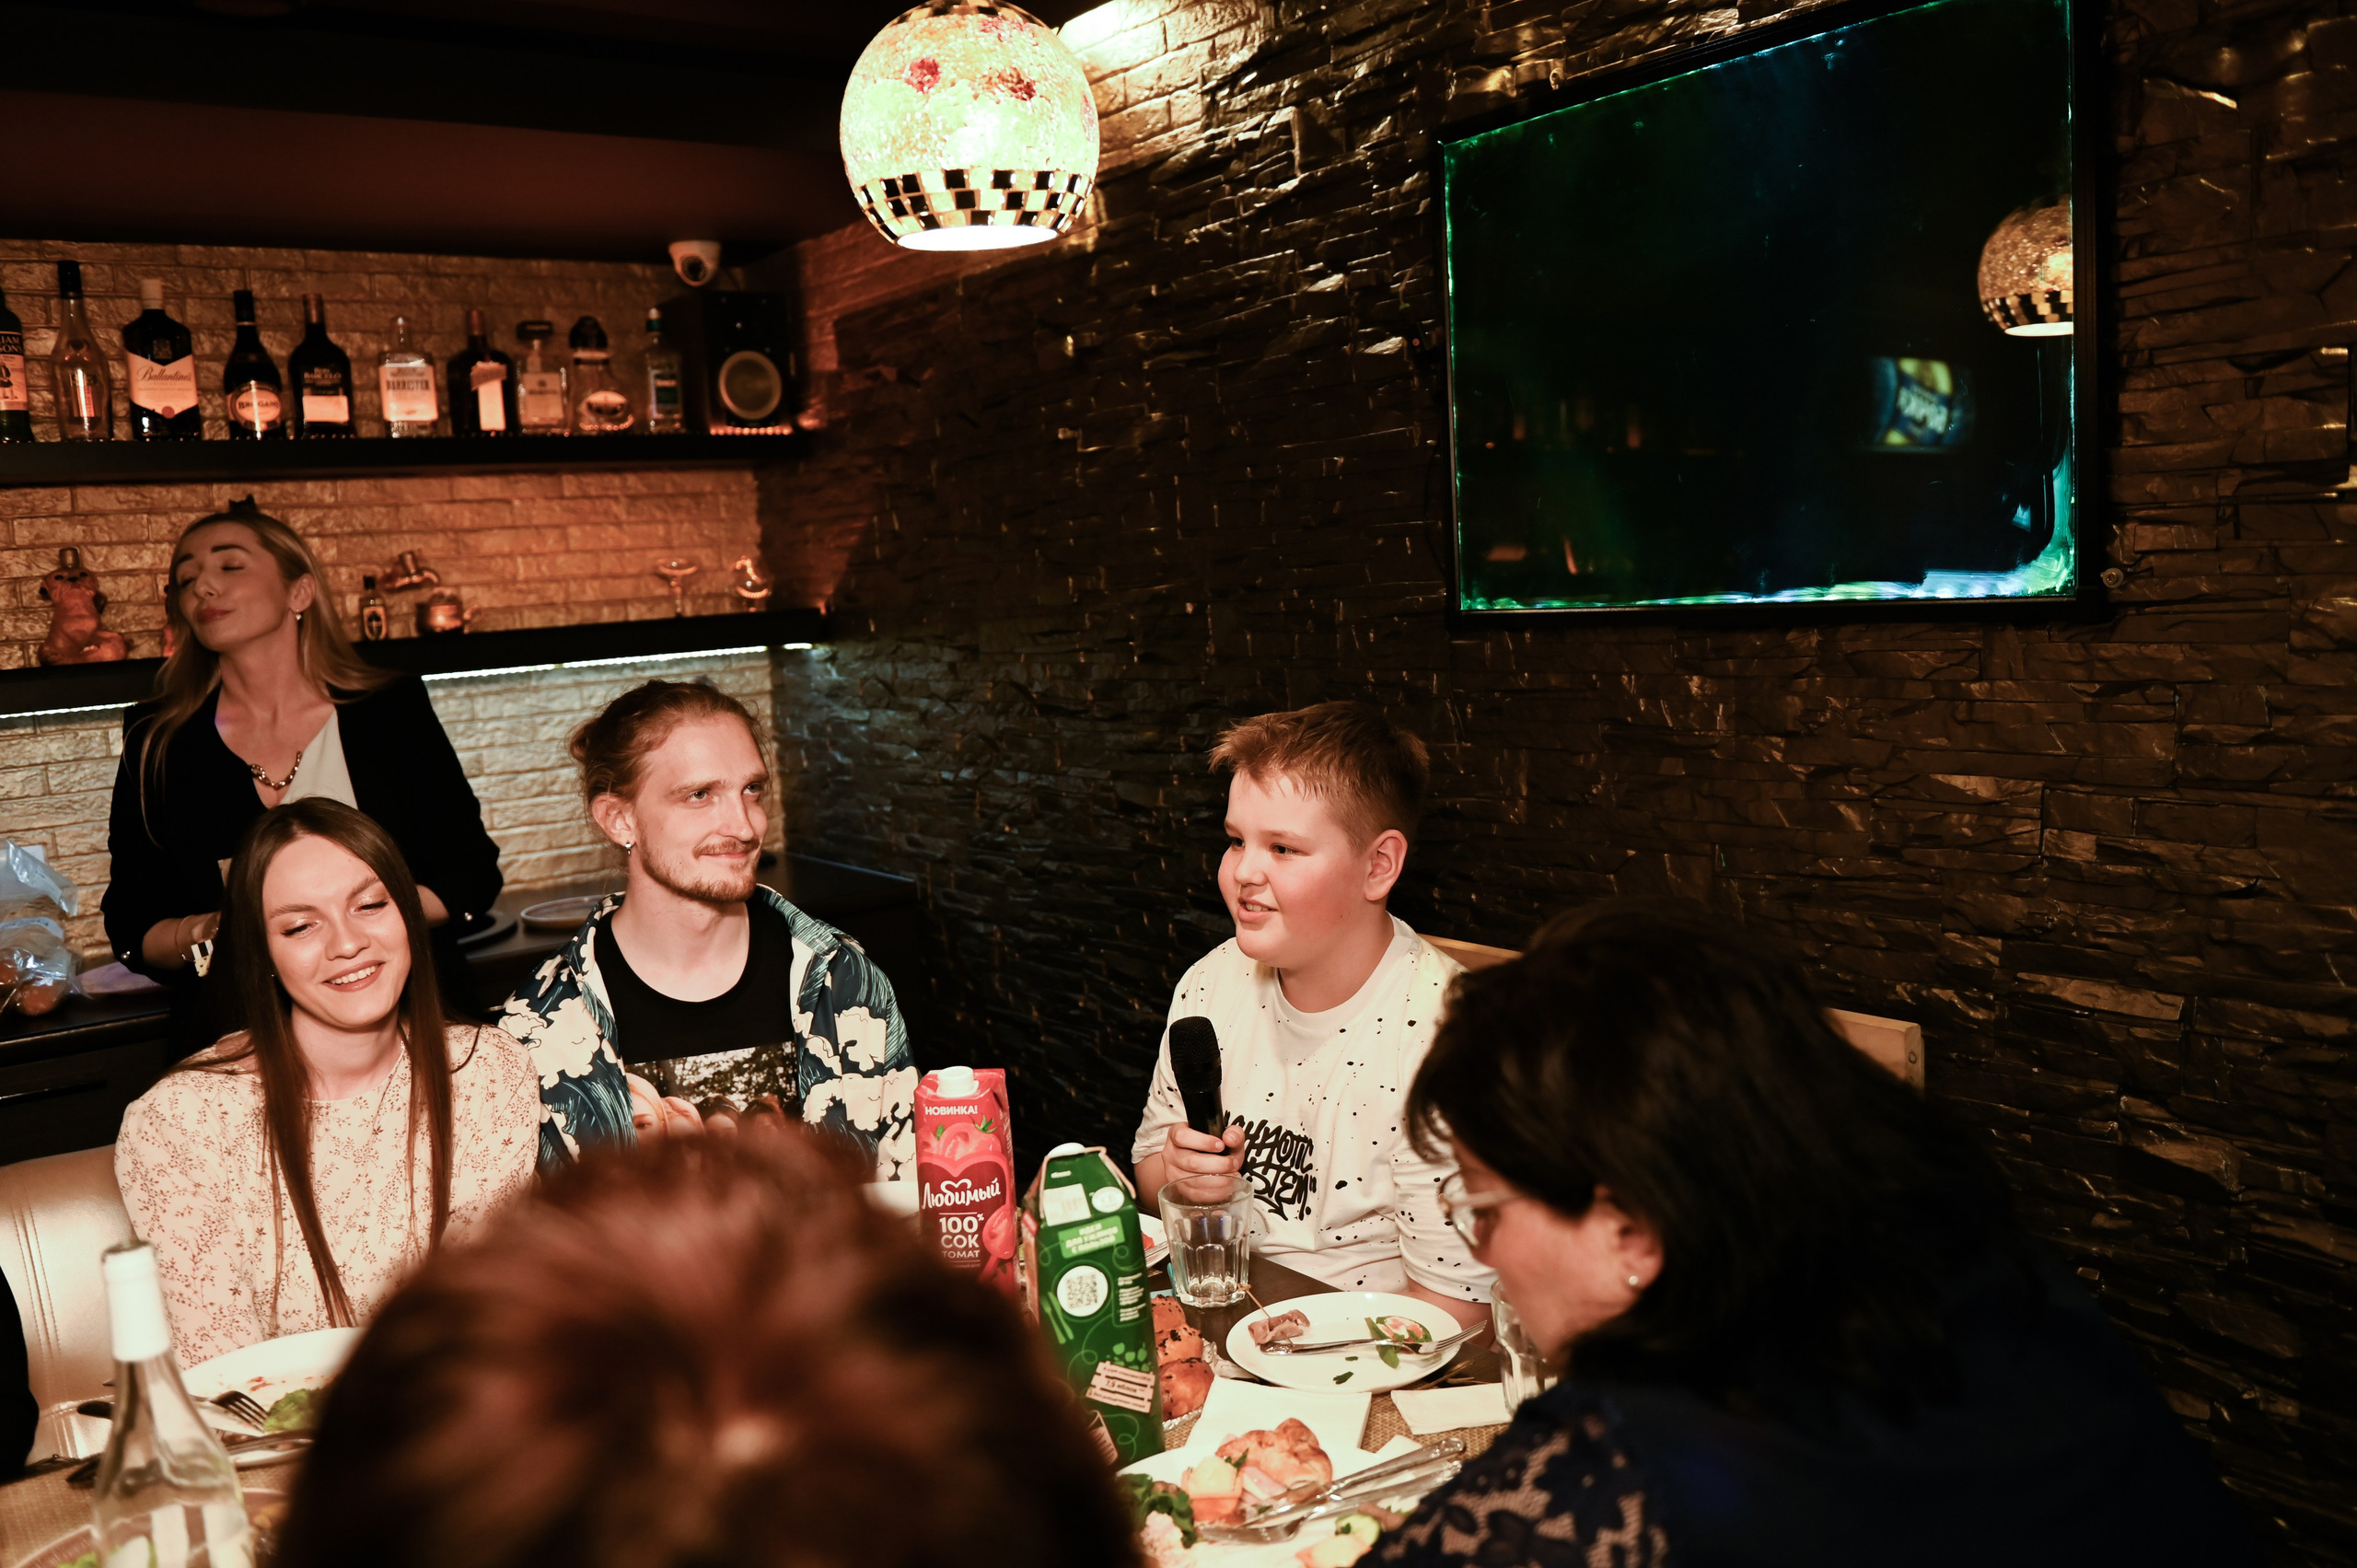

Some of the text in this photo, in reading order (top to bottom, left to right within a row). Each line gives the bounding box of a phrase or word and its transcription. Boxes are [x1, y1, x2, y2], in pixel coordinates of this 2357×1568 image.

[386, 379, 430, 390] BARRISTER
[924, 1105, 978, 1116] НОВИНКА!
[922, 1177, 1001, 1210] Любимый
[939, 1213, 984, 1235] 100%
[940, 1234, 979, 1249] СОК
[941, 1249, 980, 1260] ТОМАТ
